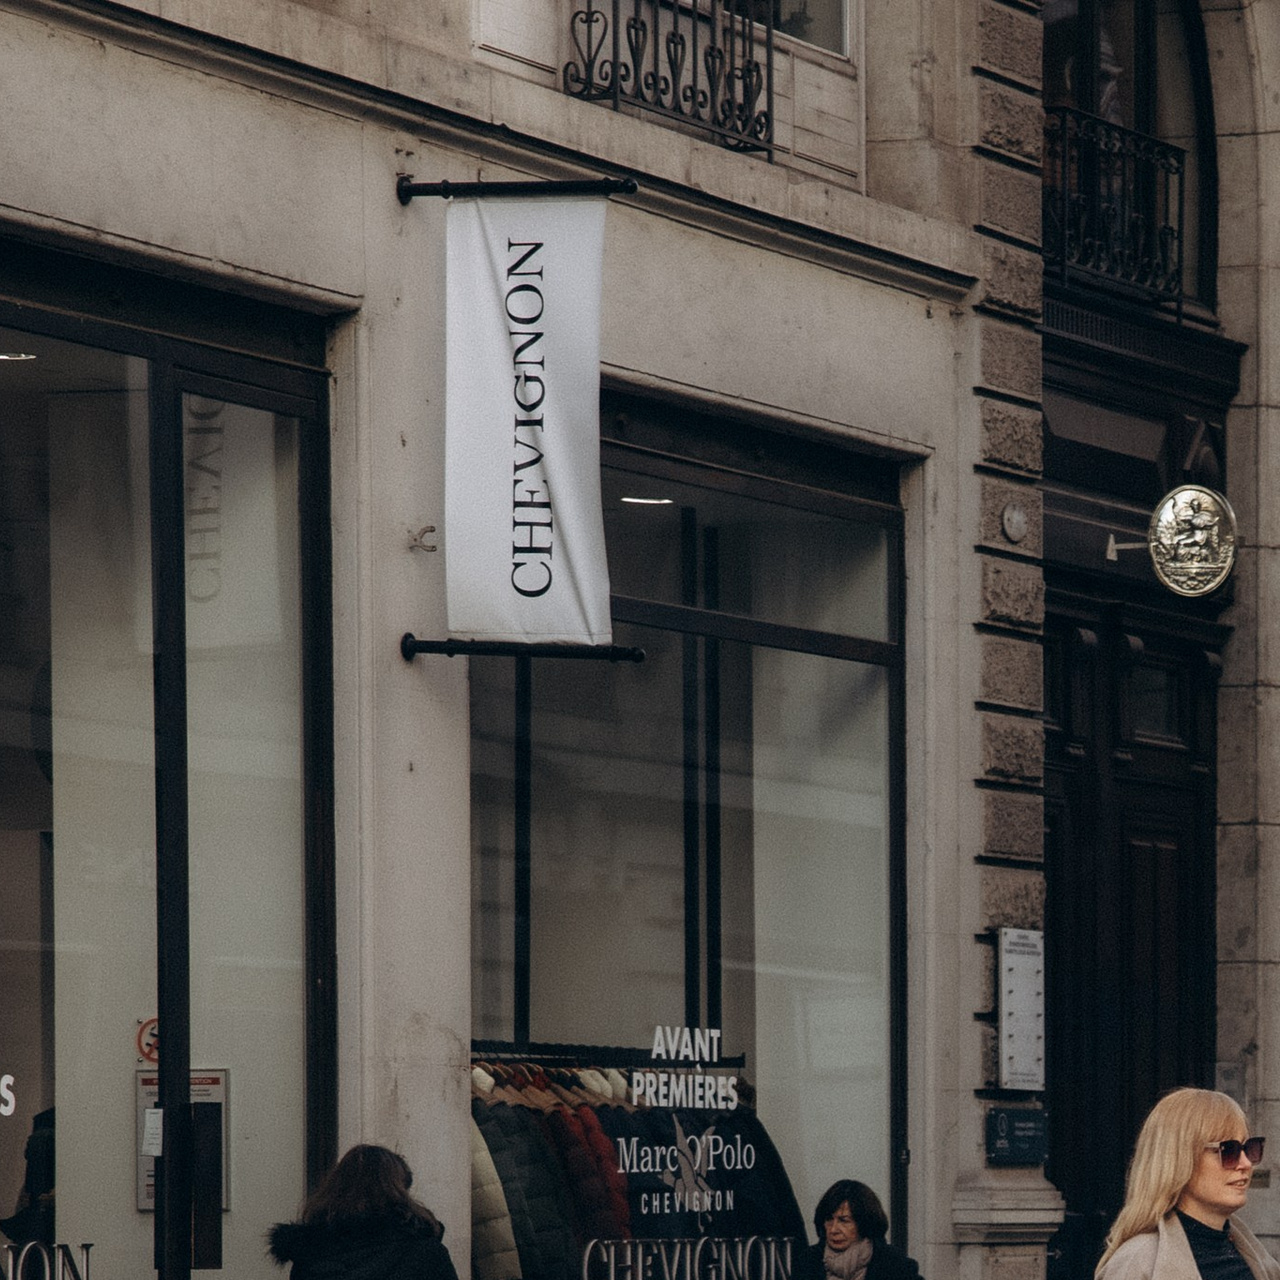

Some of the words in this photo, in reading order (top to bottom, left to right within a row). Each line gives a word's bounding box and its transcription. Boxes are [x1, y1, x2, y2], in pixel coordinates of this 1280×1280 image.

[504, 237, 553, 598] CHEVIGNON
[651, 1025, 721, 1063] AVANT
[632, 1062, 738, 1110] PREMIÈRES
[617, 1136, 679, 1174] Marc
[685, 1134, 756, 1171] O'Polo
[641, 1189, 734, 1214] CHEVIGNON
